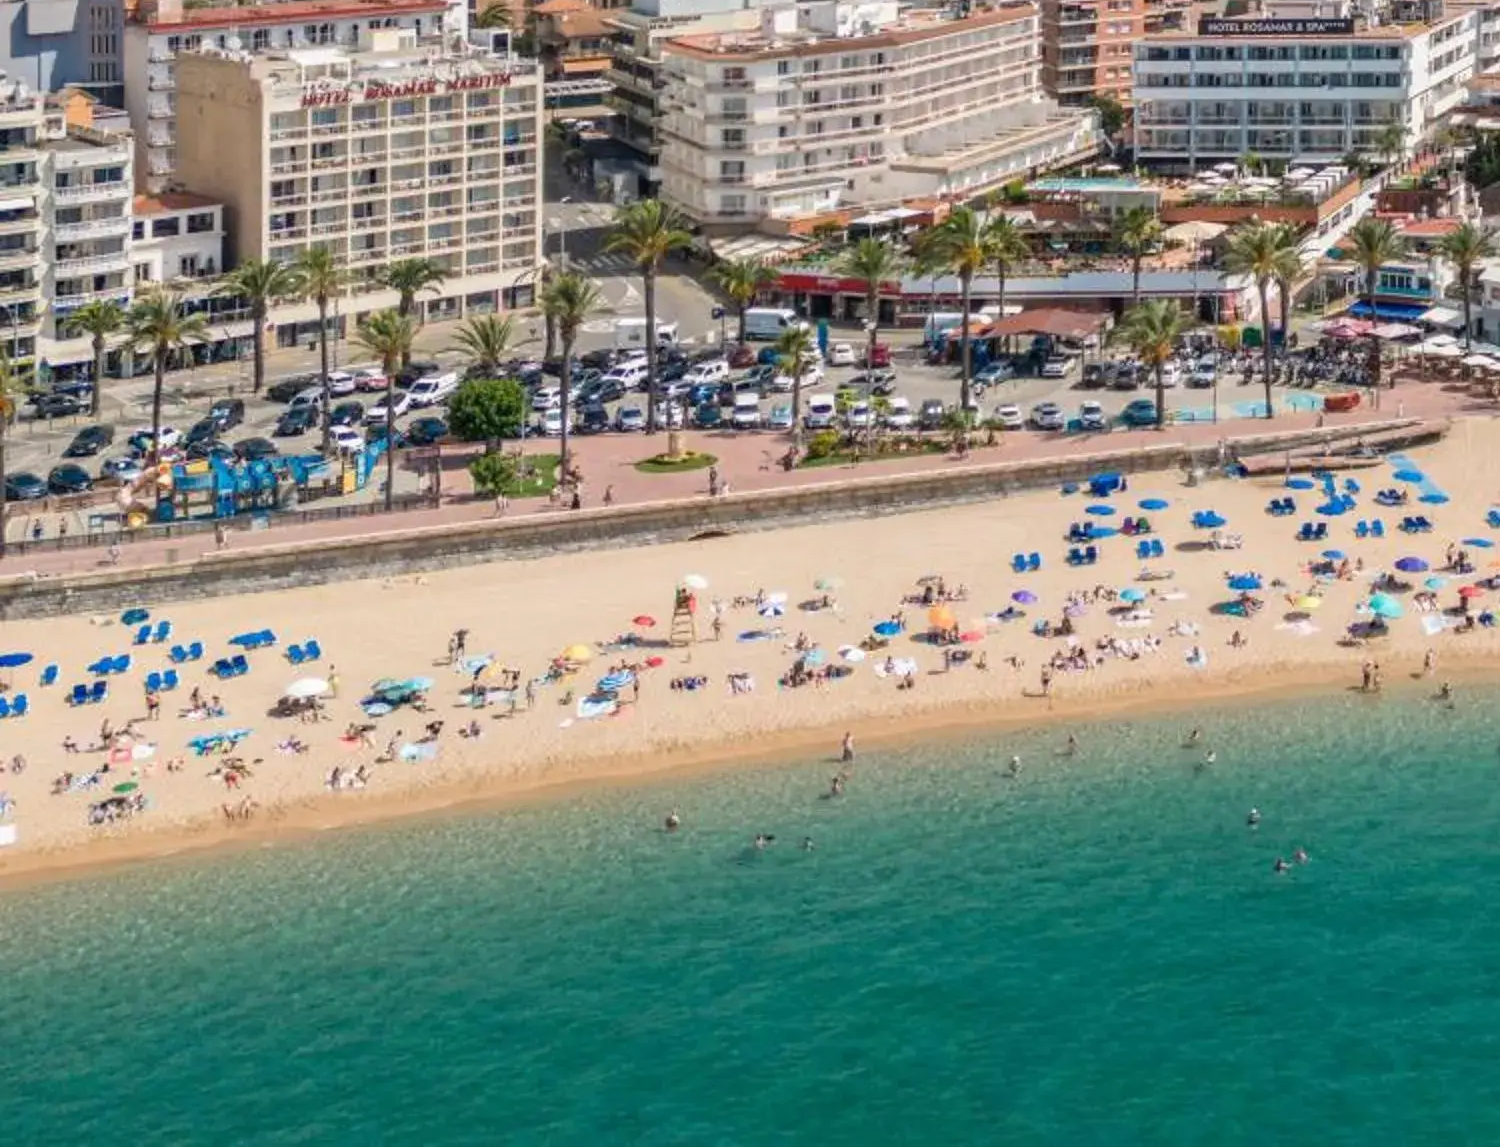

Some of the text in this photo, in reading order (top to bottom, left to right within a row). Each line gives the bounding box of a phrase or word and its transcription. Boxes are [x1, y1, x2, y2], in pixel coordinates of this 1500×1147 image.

[1207, 22, 1239, 33] HOTEL
[1241, 21, 1293, 32] ROSAMAR
[301, 73, 512, 107] HOTEL ROSAMAR MARITIM
